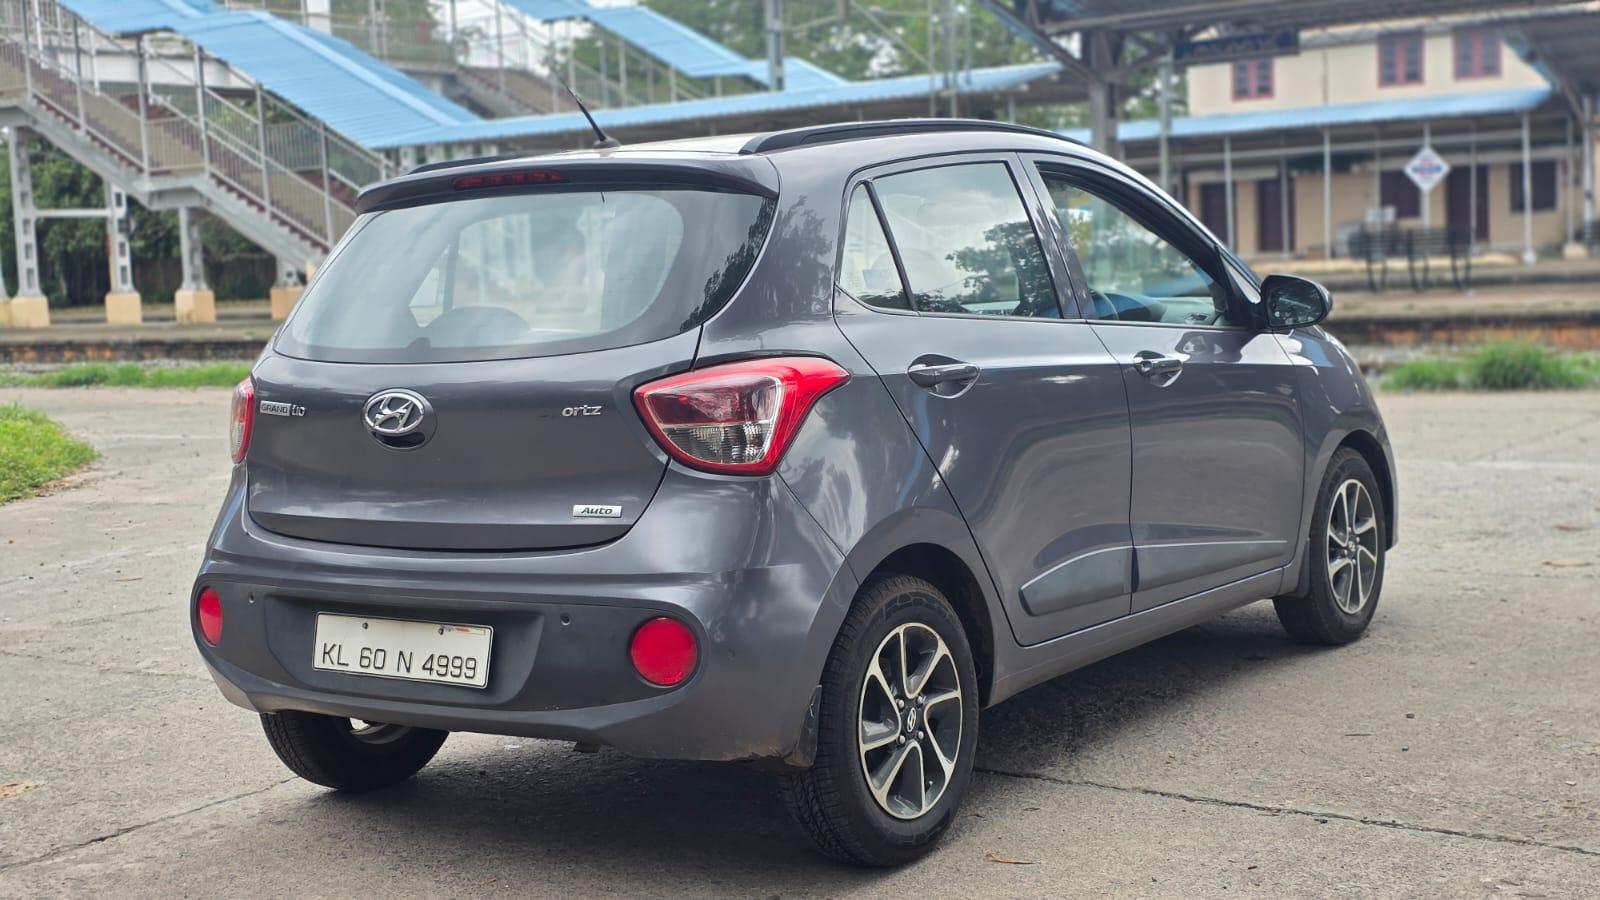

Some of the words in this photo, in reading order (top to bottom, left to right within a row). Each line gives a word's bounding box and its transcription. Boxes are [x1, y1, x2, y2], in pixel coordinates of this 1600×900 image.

[261, 403, 288, 415] GRAND
[562, 404, 602, 417] ortz
[581, 506, 613, 515] Auto
[322, 642, 349, 667] KL
[359, 647, 386, 670] 60
[397, 650, 413, 673] N
[422, 653, 477, 680] 4999
